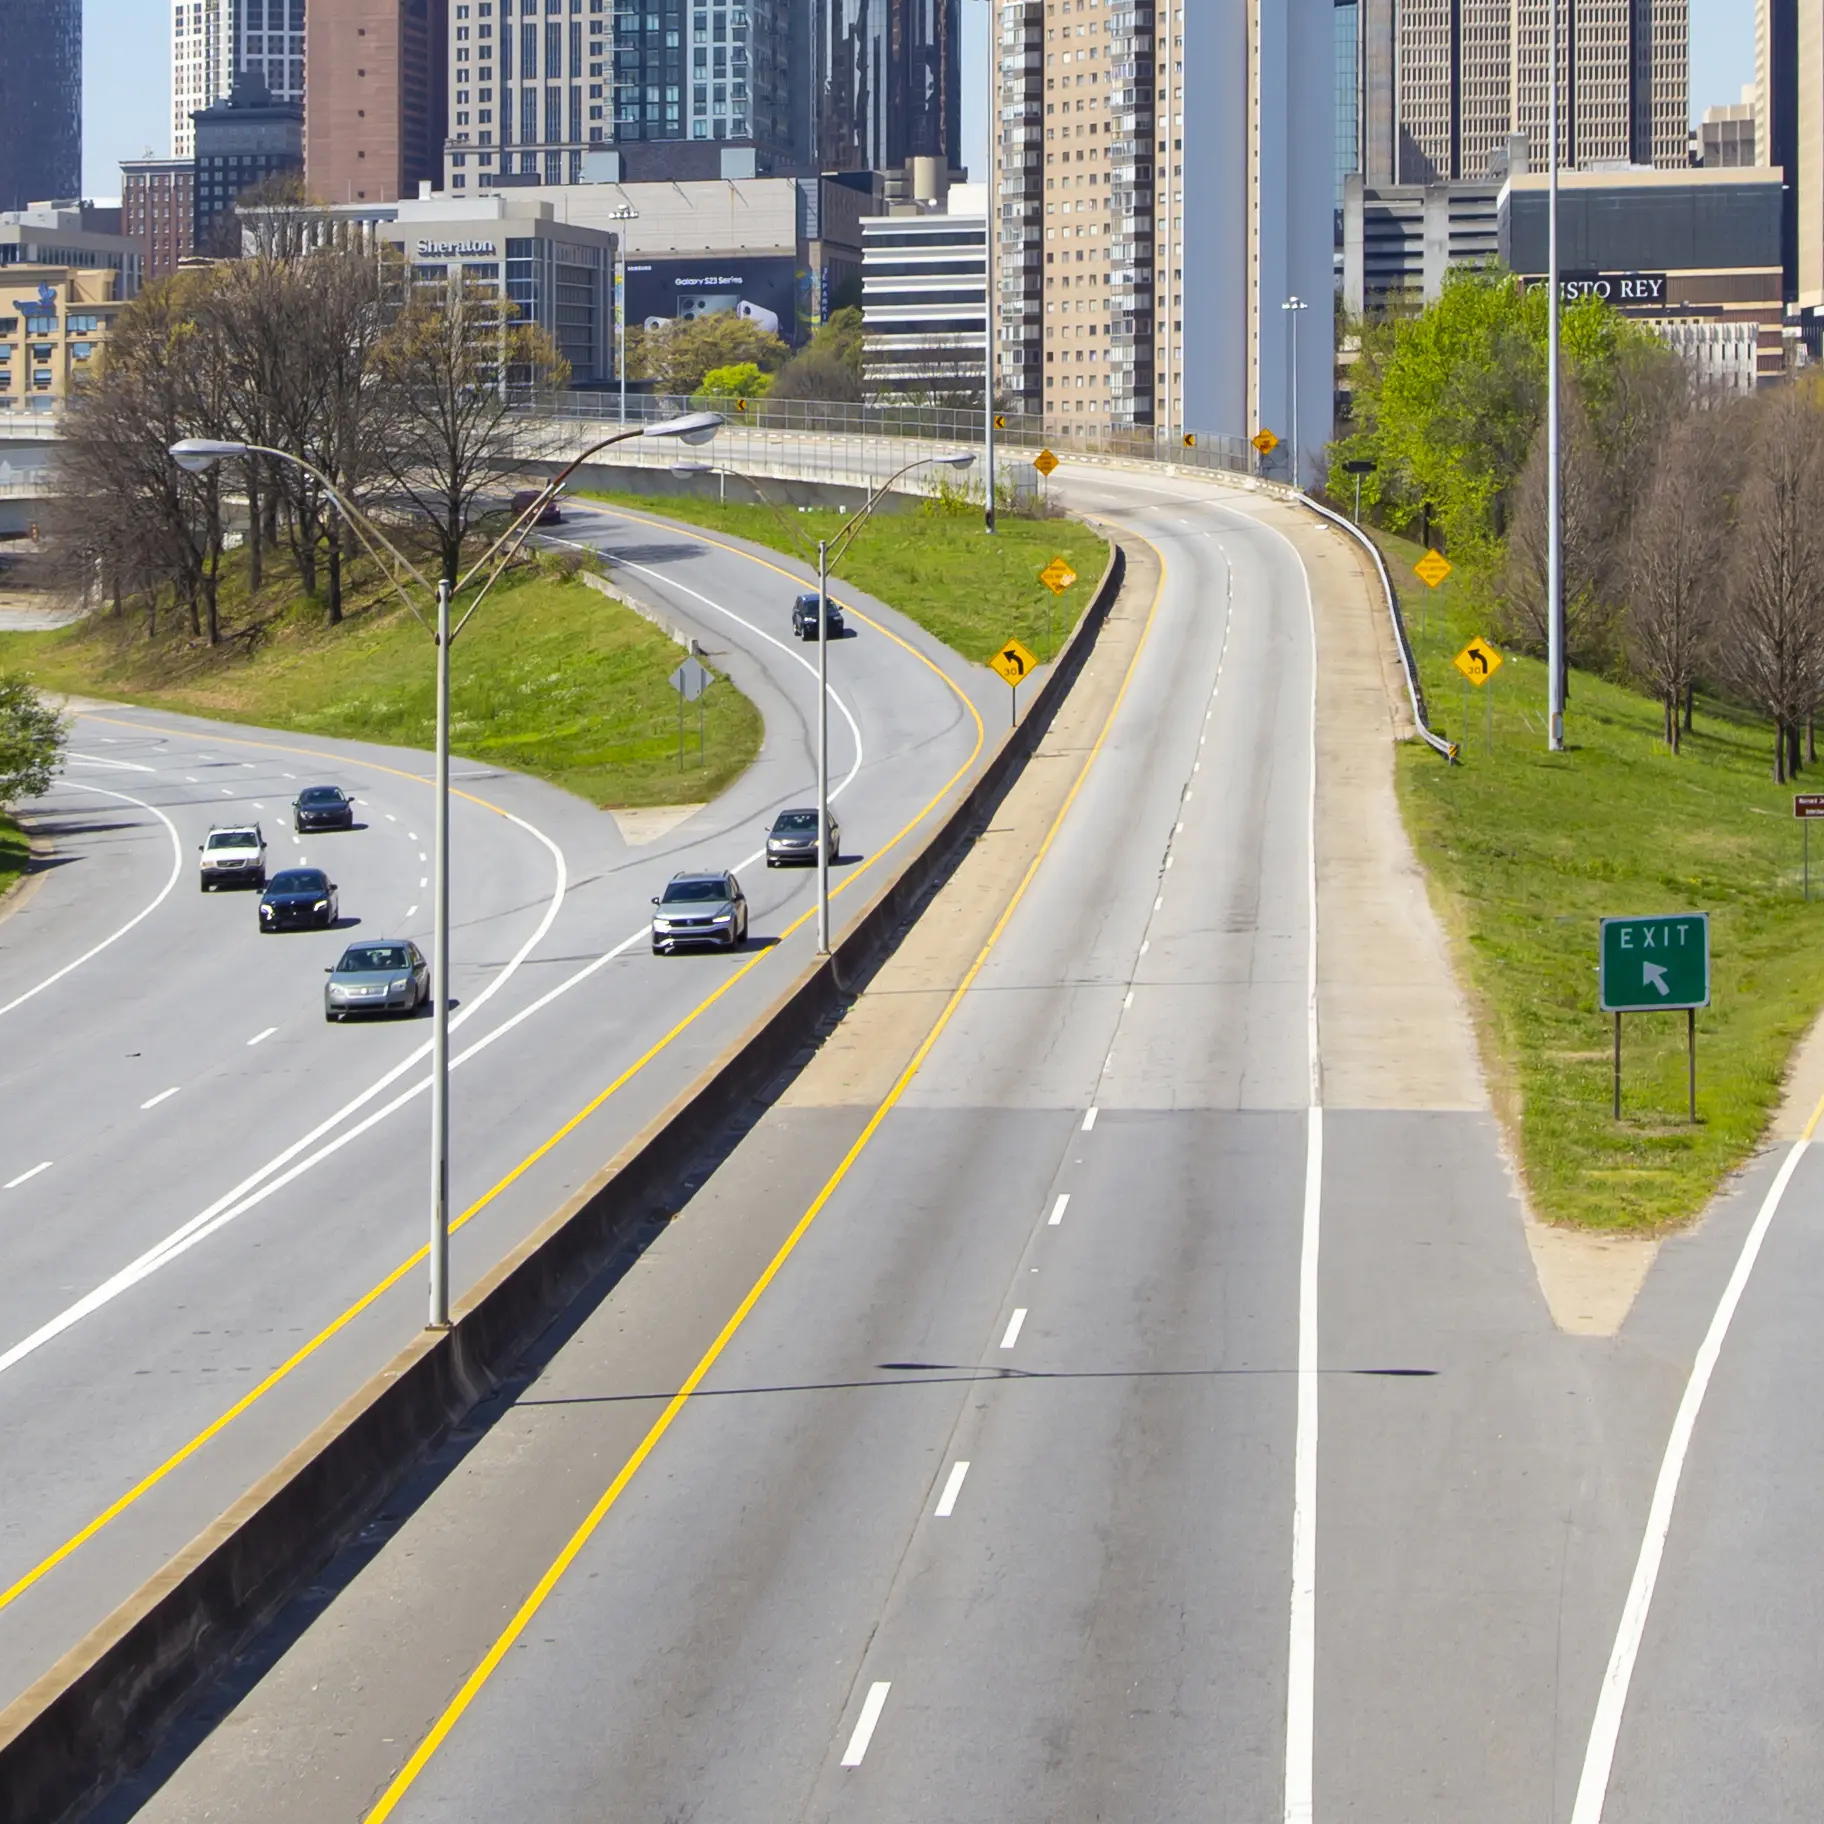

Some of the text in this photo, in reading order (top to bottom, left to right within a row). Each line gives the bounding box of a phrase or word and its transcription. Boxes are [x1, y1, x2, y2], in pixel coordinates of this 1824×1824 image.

[417, 238, 495, 255] Sheraton
[675, 276, 743, 286] Galaxy S23 Series
[1527, 279, 1663, 300] CISTO REY
[1004, 667, 1017, 676] 30
[1467, 666, 1480, 675] 30
[1620, 925, 1689, 949] EXIT
